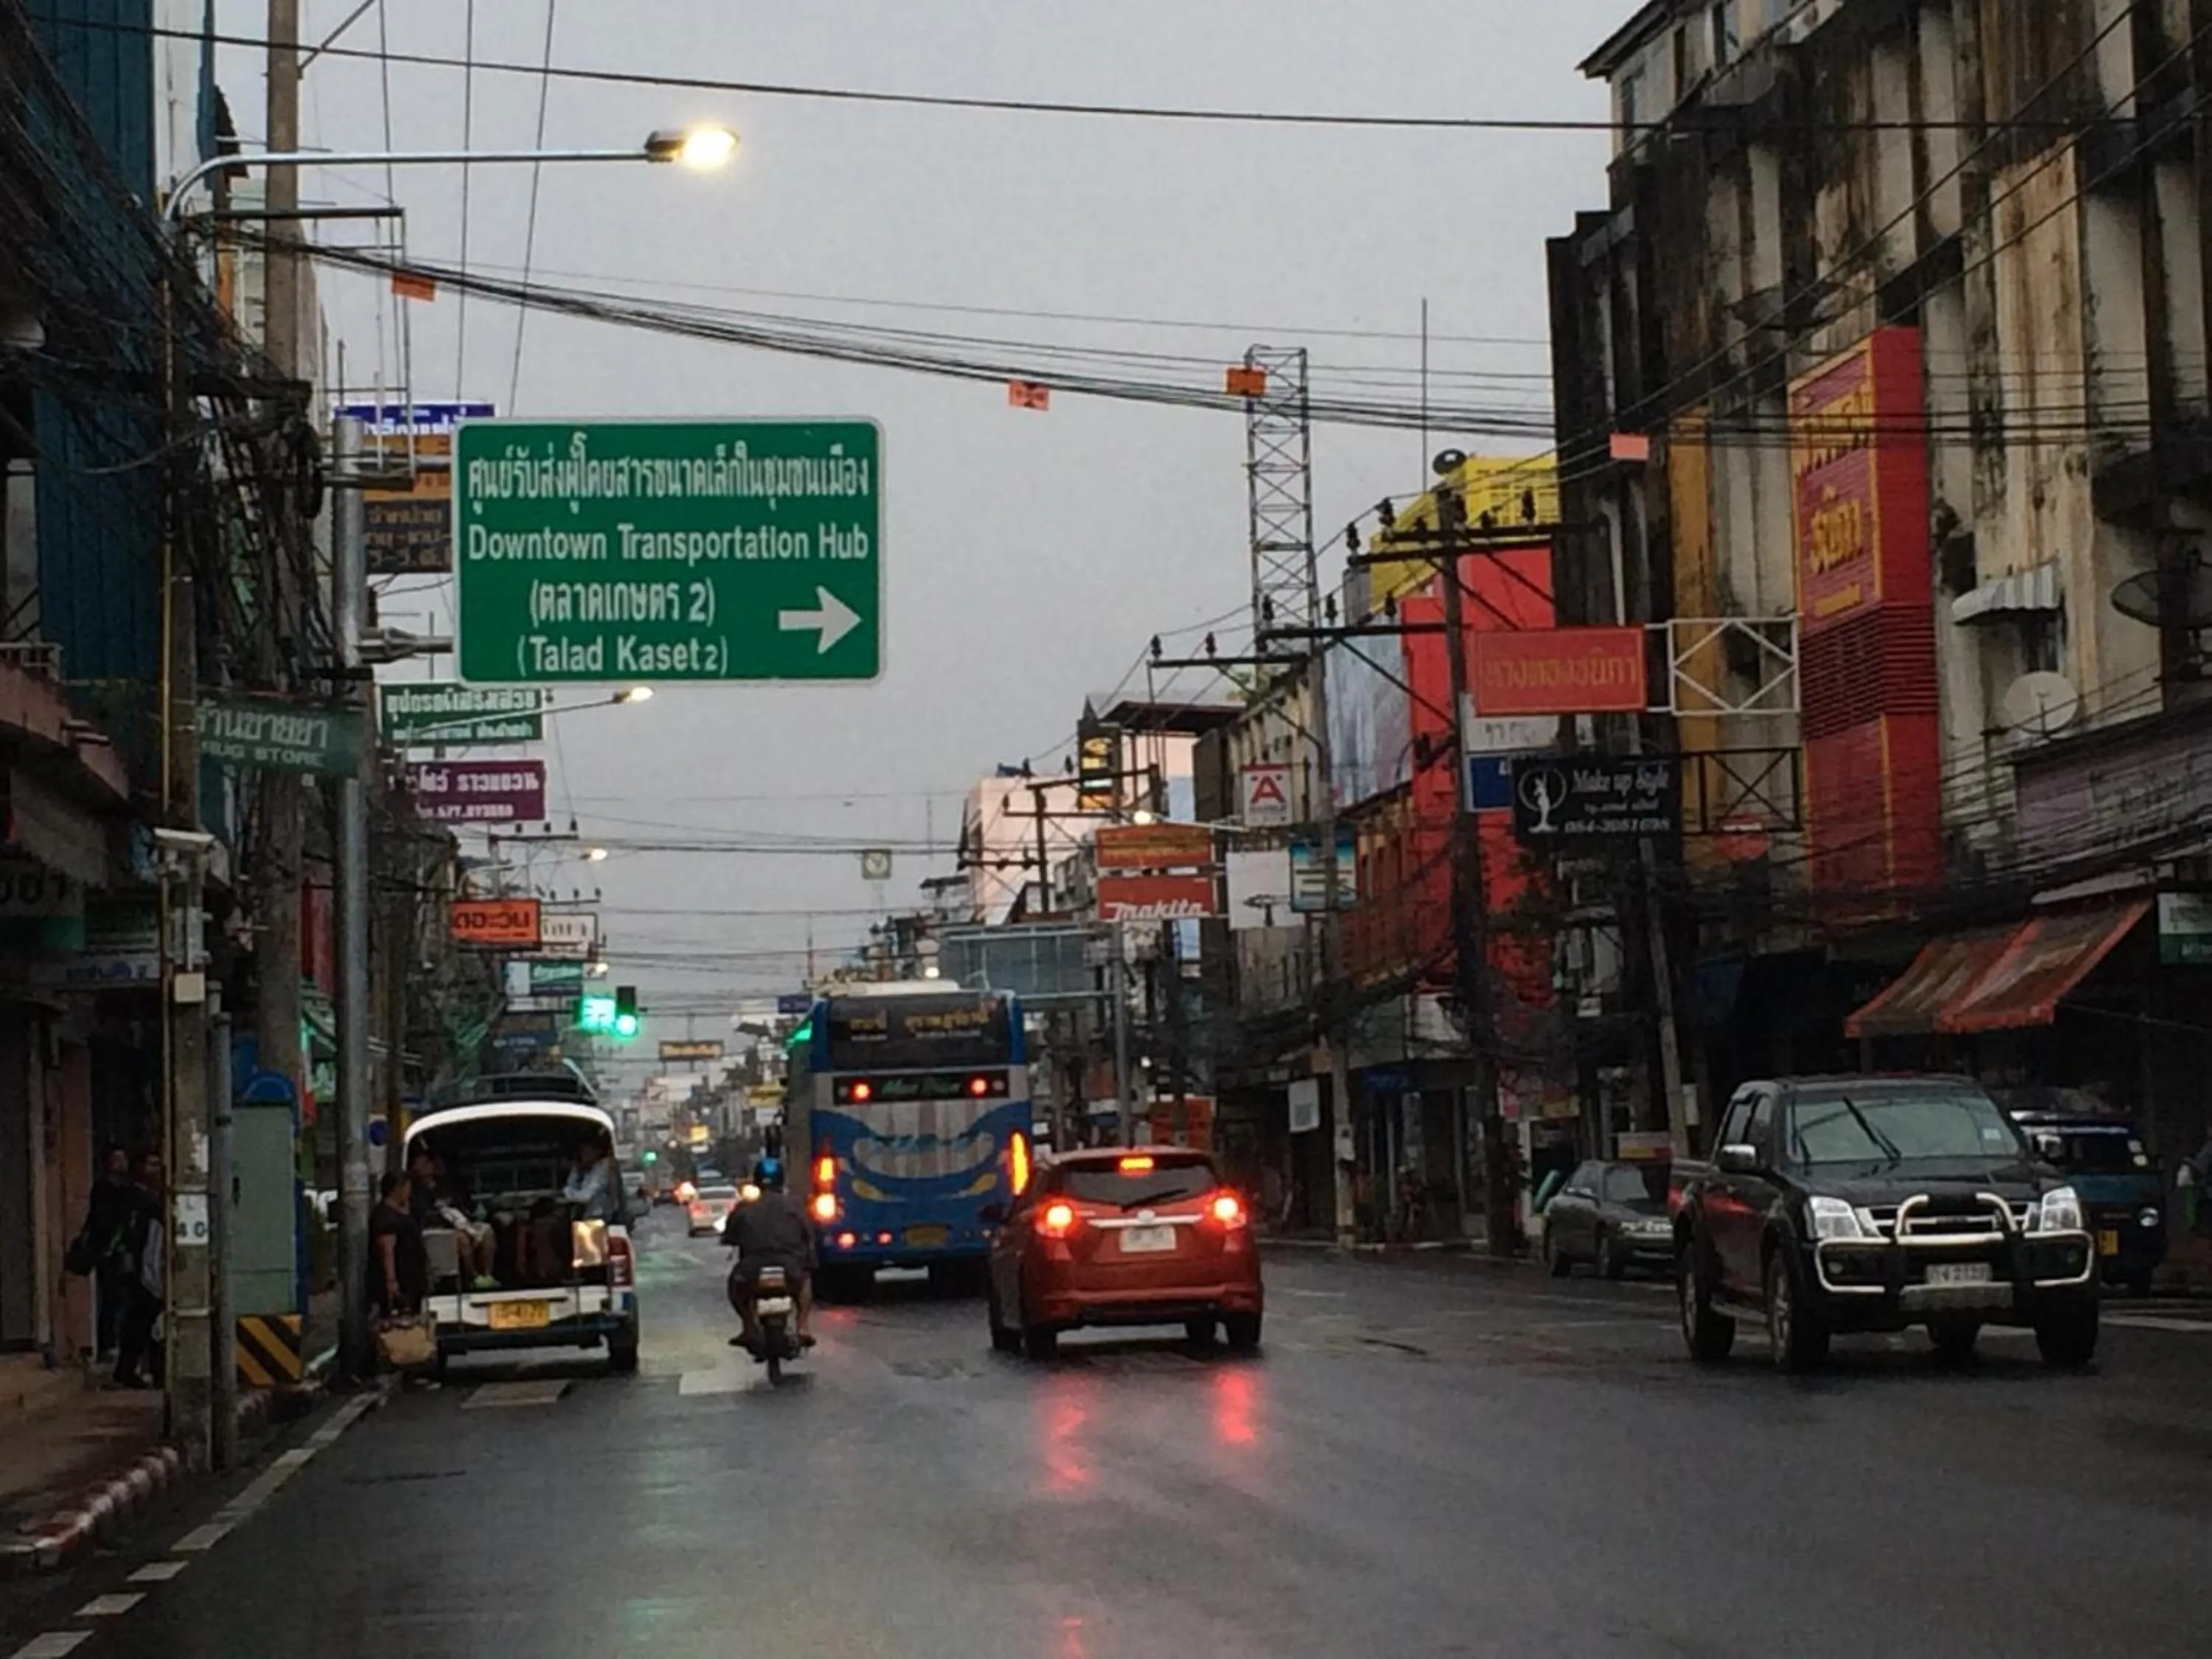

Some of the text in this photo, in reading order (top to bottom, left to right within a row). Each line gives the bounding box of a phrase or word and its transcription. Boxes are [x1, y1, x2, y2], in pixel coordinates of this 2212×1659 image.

[468, 524, 608, 560] Downtown
[617, 523, 810, 567] Transportation
[818, 523, 869, 560] Hub
[518, 636, 604, 677] (Talad
[254, 745, 326, 768] STORE
